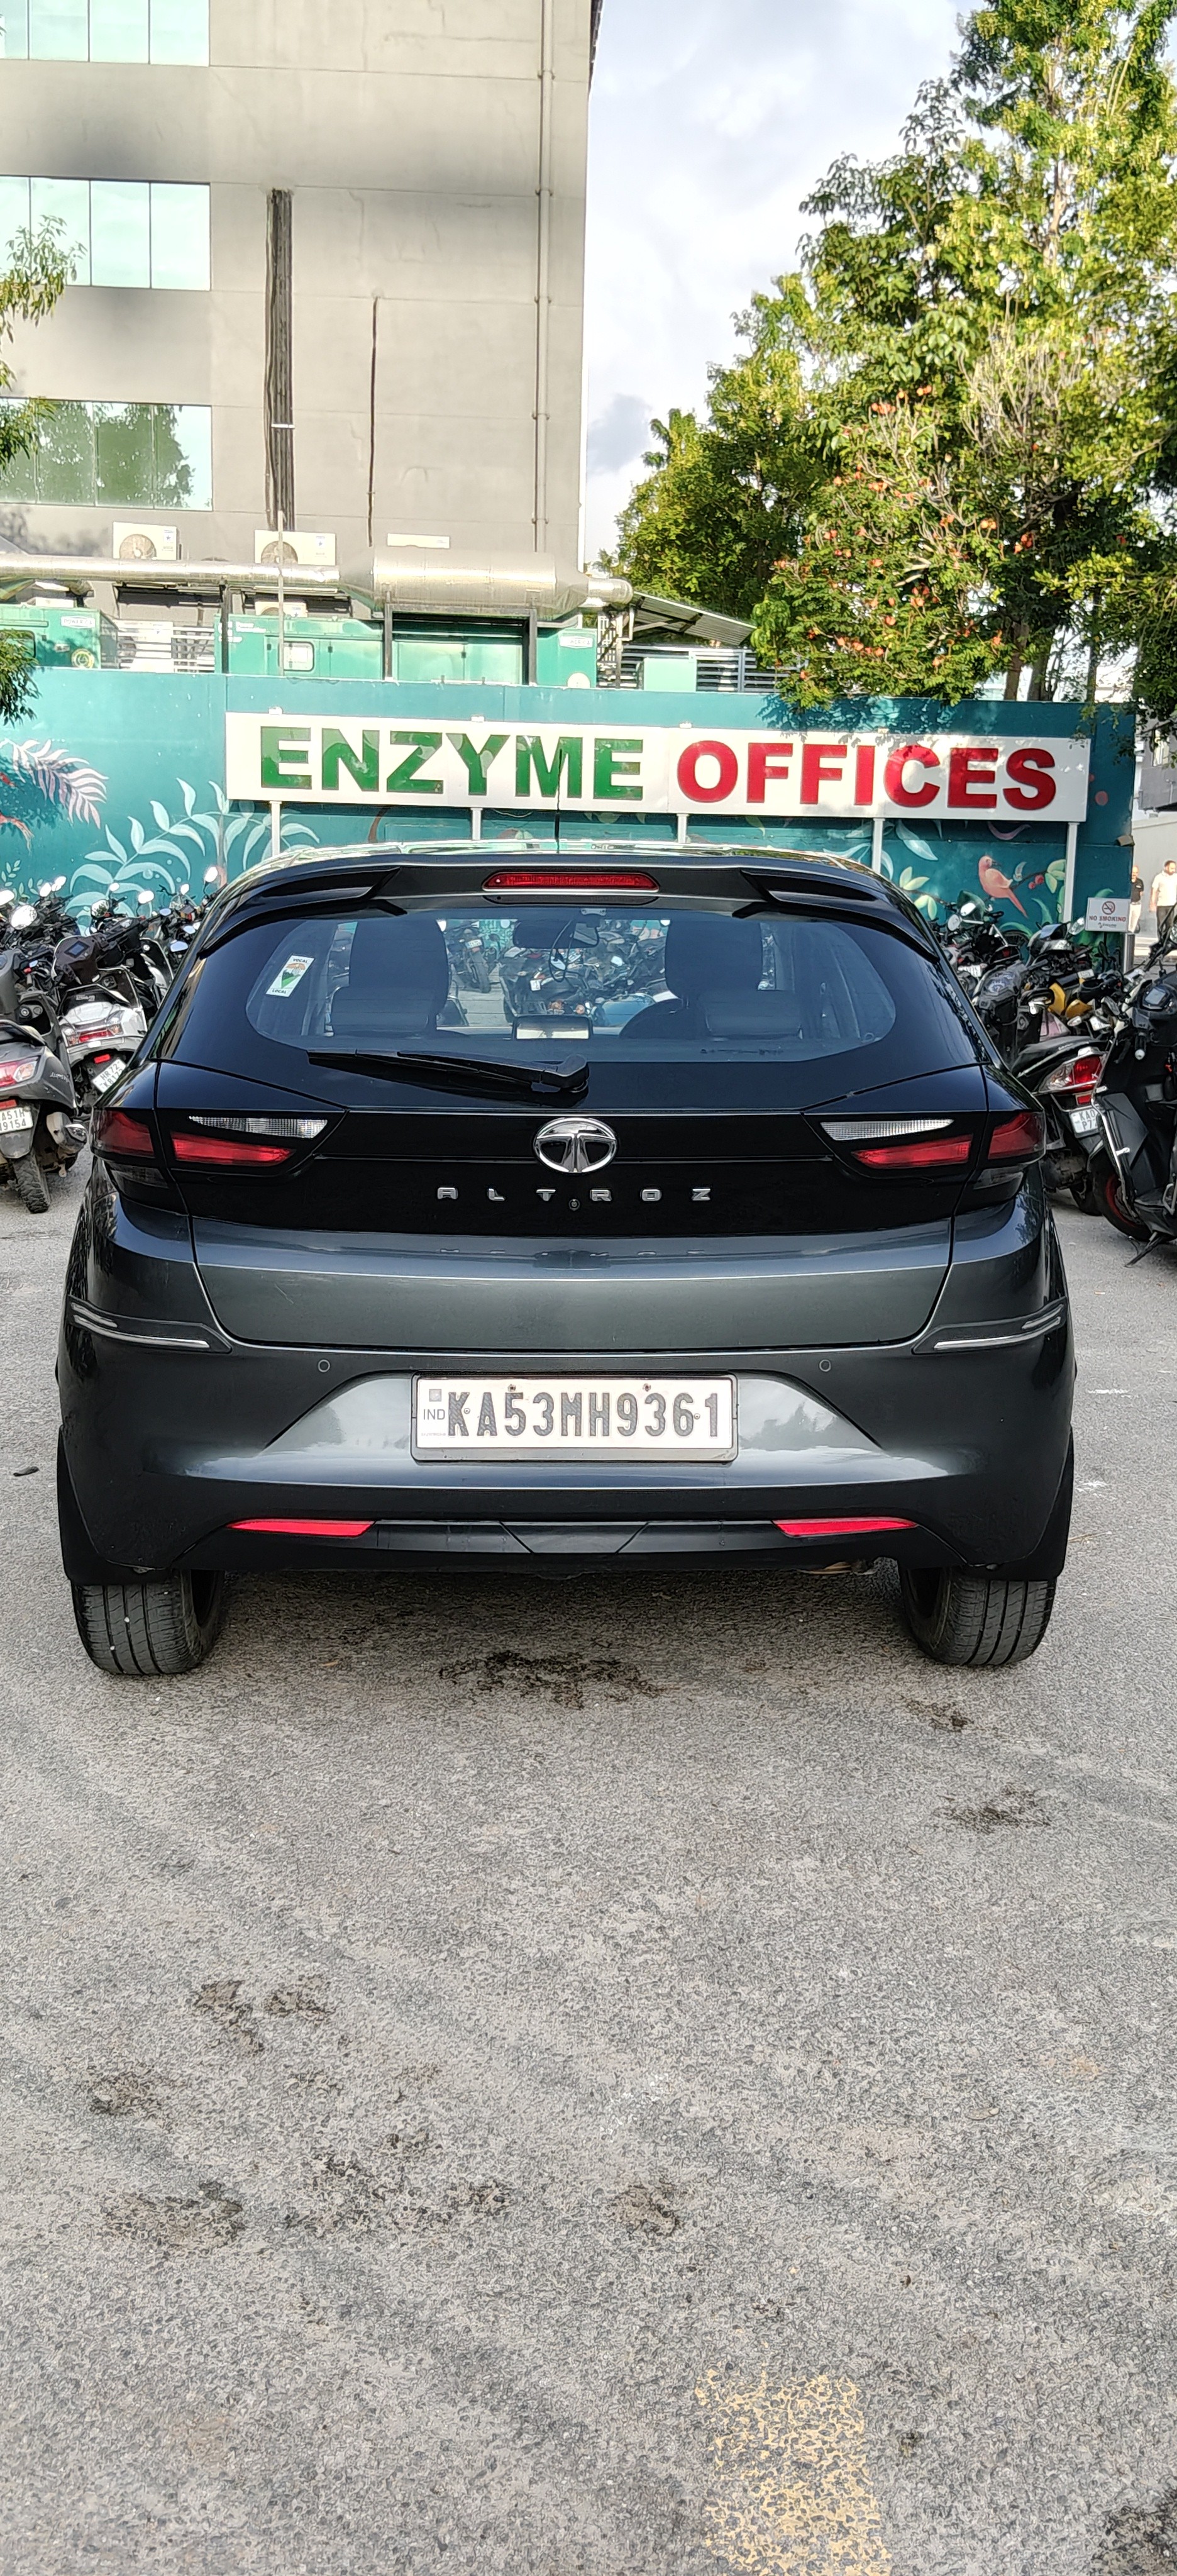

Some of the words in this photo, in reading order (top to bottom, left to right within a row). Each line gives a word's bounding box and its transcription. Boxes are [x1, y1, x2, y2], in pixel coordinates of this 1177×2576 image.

[260, 726, 643, 801] ENZYME
[677, 740, 1057, 811] OFFICES
[100, 1063, 120, 1081] HR72
[0, 1108, 25, 1121] A51H
[1079, 1109, 1097, 1121] KA0
[1081, 1119, 1097, 1131] P7
[437, 1187, 711, 1202] ALTROZ
[423, 1409, 446, 1420] IND
[448, 1392, 719, 1437] KA53MH9361
